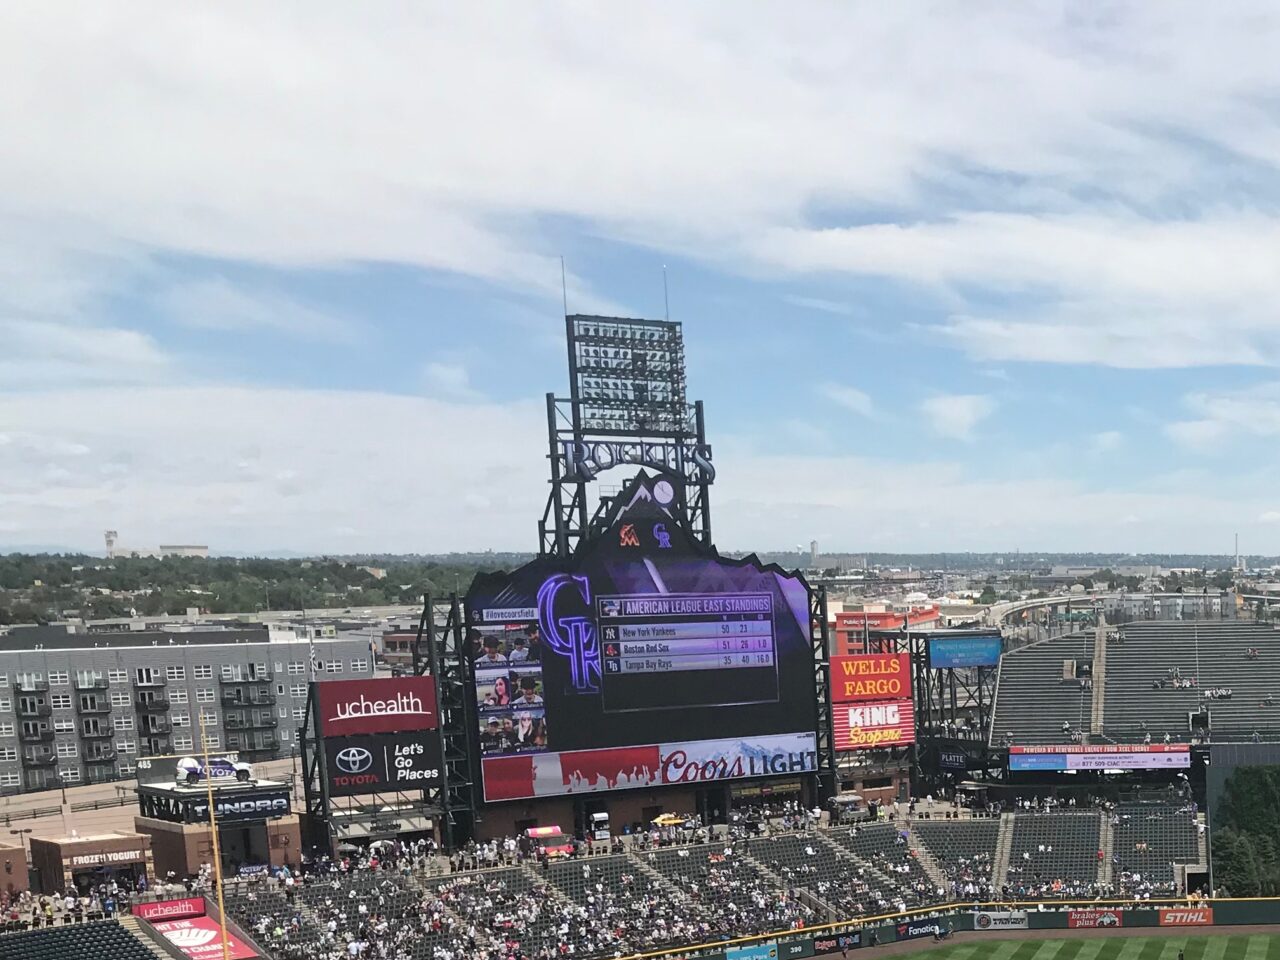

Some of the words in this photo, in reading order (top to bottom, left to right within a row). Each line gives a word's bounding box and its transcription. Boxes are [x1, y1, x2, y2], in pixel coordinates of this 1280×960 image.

[626, 601, 669, 614] AMERICAN
[671, 600, 702, 613] LEAGUE
[704, 599, 723, 612] EAST
[725, 598, 769, 611] STANDINGS
[623, 627, 635, 637] New
[637, 627, 650, 636] York
[651, 626, 676, 637] Yankees
[721, 624, 730, 633] 50
[740, 624, 748, 633] 23
[624, 645, 647, 654] Boston
[649, 644, 657, 652] Red
[658, 644, 669, 652] Sox
[722, 640, 730, 649] 51
[625, 661, 646, 670] Tampa
[646, 660, 657, 669] Bay
[658, 660, 672, 669] Rays
[724, 656, 731, 665] 35
[741, 655, 750, 664] 40
[757, 654, 770, 663] 16.0
[841, 659, 900, 676] WELLS
[844, 679, 900, 696] FARGO
[337, 691, 422, 718] uchealth
[849, 705, 899, 727] KING
[395, 743, 424, 756] Let's
[137, 760, 151, 768] 485
[395, 757, 413, 768] Go
[661, 750, 745, 784] Coors
[749, 751, 817, 776] LIGHT
[196, 766, 237, 777] TOYOTA
[397, 769, 438, 781] Places
[334, 774, 379, 786] TOYOTA
[194, 799, 288, 817] TUNDRA
[73, 854, 106, 865] FROZEN
[107, 850, 141, 861] YOGURT
[145, 902, 193, 917] uchealth
[1076, 919, 1094, 927] plus
[1164, 912, 1207, 923] STIHL
